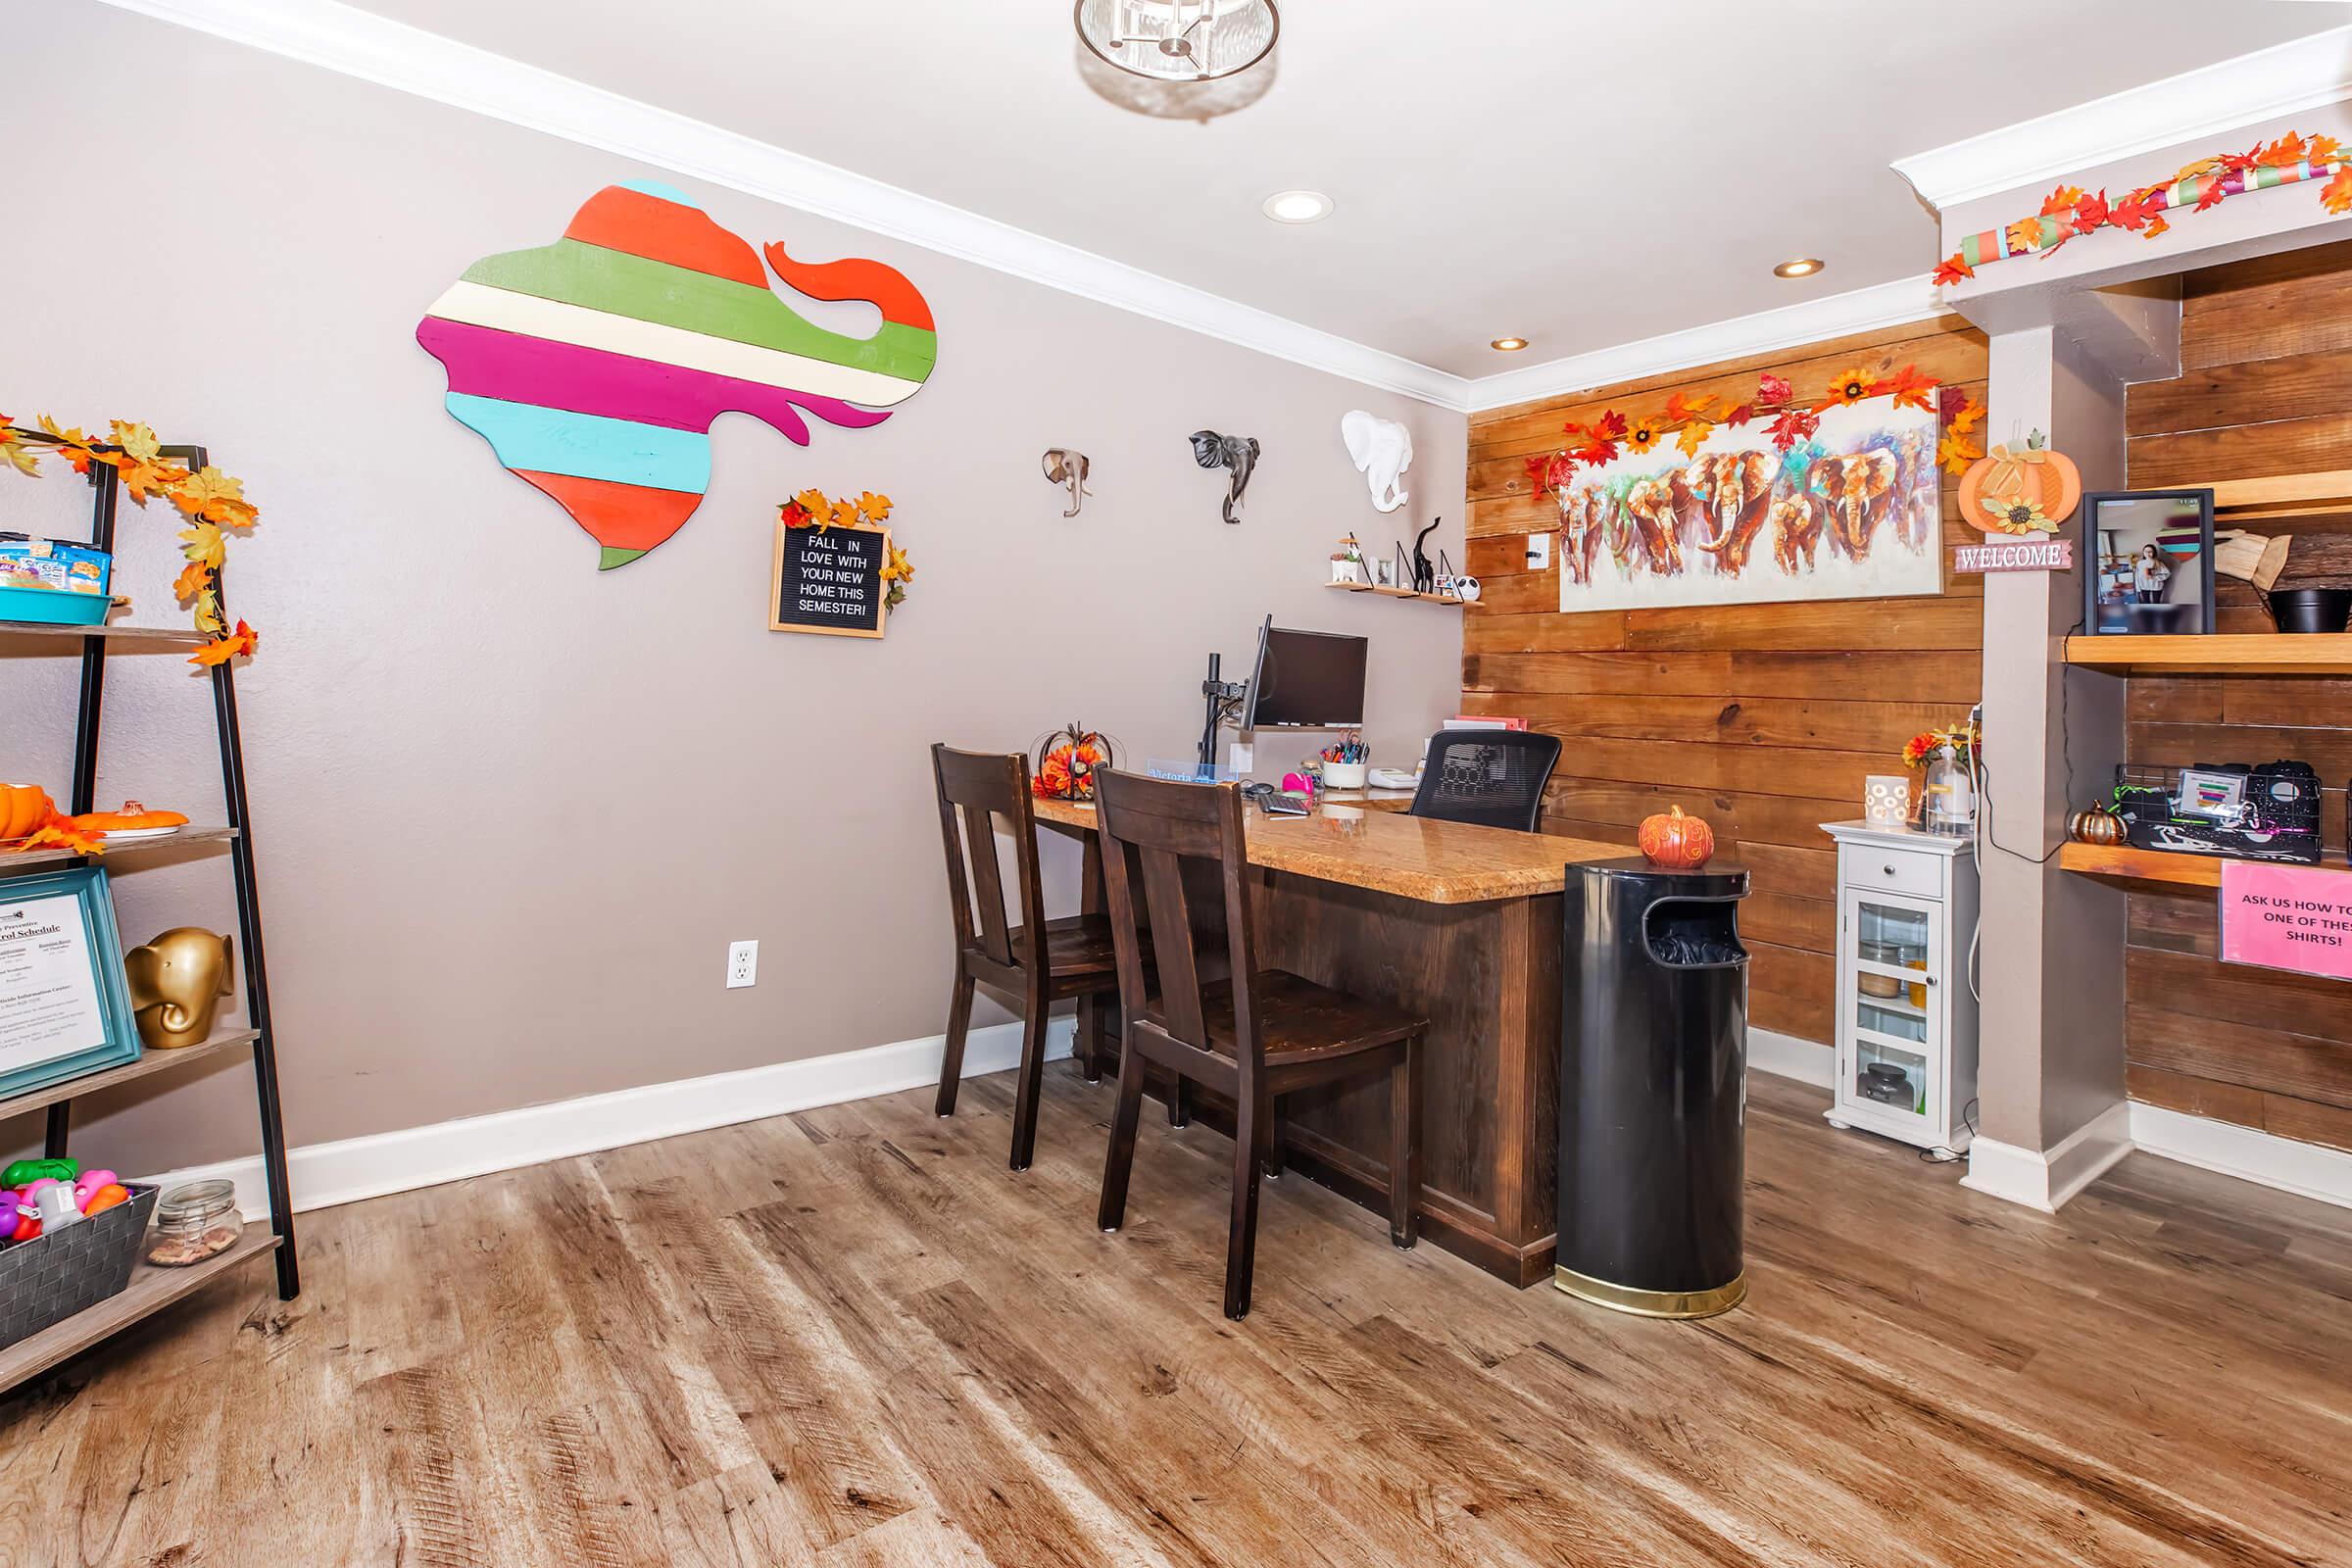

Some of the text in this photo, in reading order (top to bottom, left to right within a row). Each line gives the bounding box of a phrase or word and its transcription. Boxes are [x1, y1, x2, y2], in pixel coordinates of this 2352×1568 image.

[808, 535, 860, 553] FALL IN
[801, 550, 867, 569] LOVE WITH
[1960, 544, 2063, 569] WELCOME
[801, 566, 864, 584] YOUR NEW
[800, 583, 864, 601] HOME THIS
[1149, 768, 1192, 782] Victoria
[2242, 894, 2269, 906] ASK
[2273, 898, 2291, 908] US
[2294, 901, 2332, 913] HOW
[2264, 912, 2352, 932] ONE OF THE
[0, 924, 61, 941] rol Schedule
[2286, 930, 2342, 947] SHIRTS!
